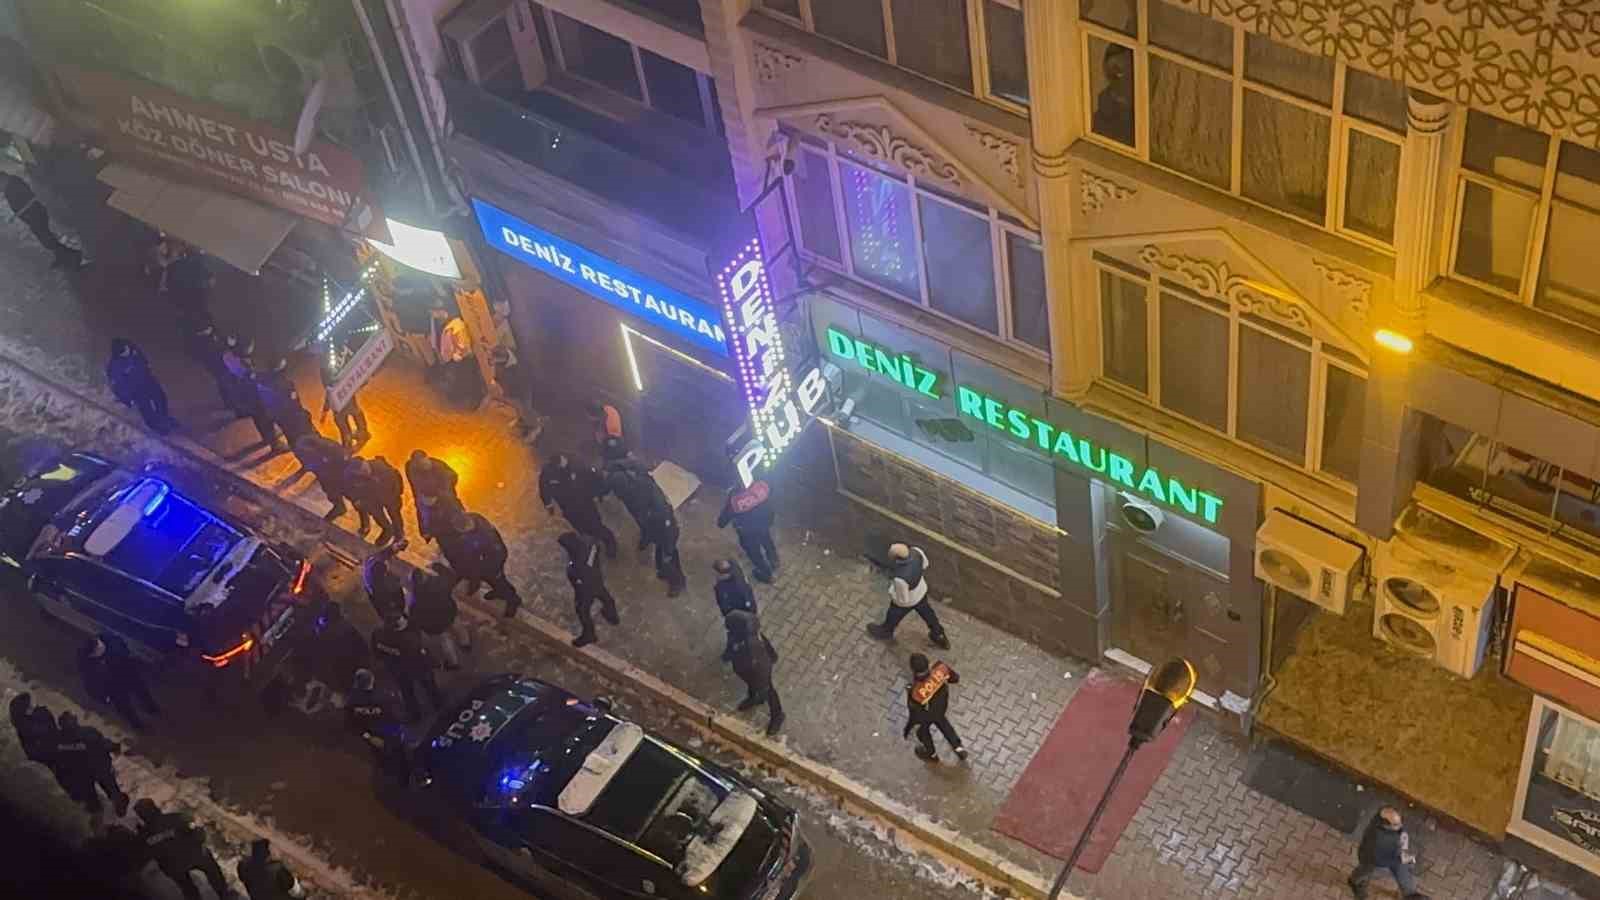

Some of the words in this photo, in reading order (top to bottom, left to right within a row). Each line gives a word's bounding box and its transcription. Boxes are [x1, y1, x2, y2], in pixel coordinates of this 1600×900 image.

[130, 95, 237, 147] AHMET
[245, 131, 331, 178] USTA
[501, 226, 576, 275] DENİZ
[579, 263, 727, 343] RESTAURAN
[827, 327, 941, 400] DENİZ
[956, 384, 1225, 524] RESTAURANT
